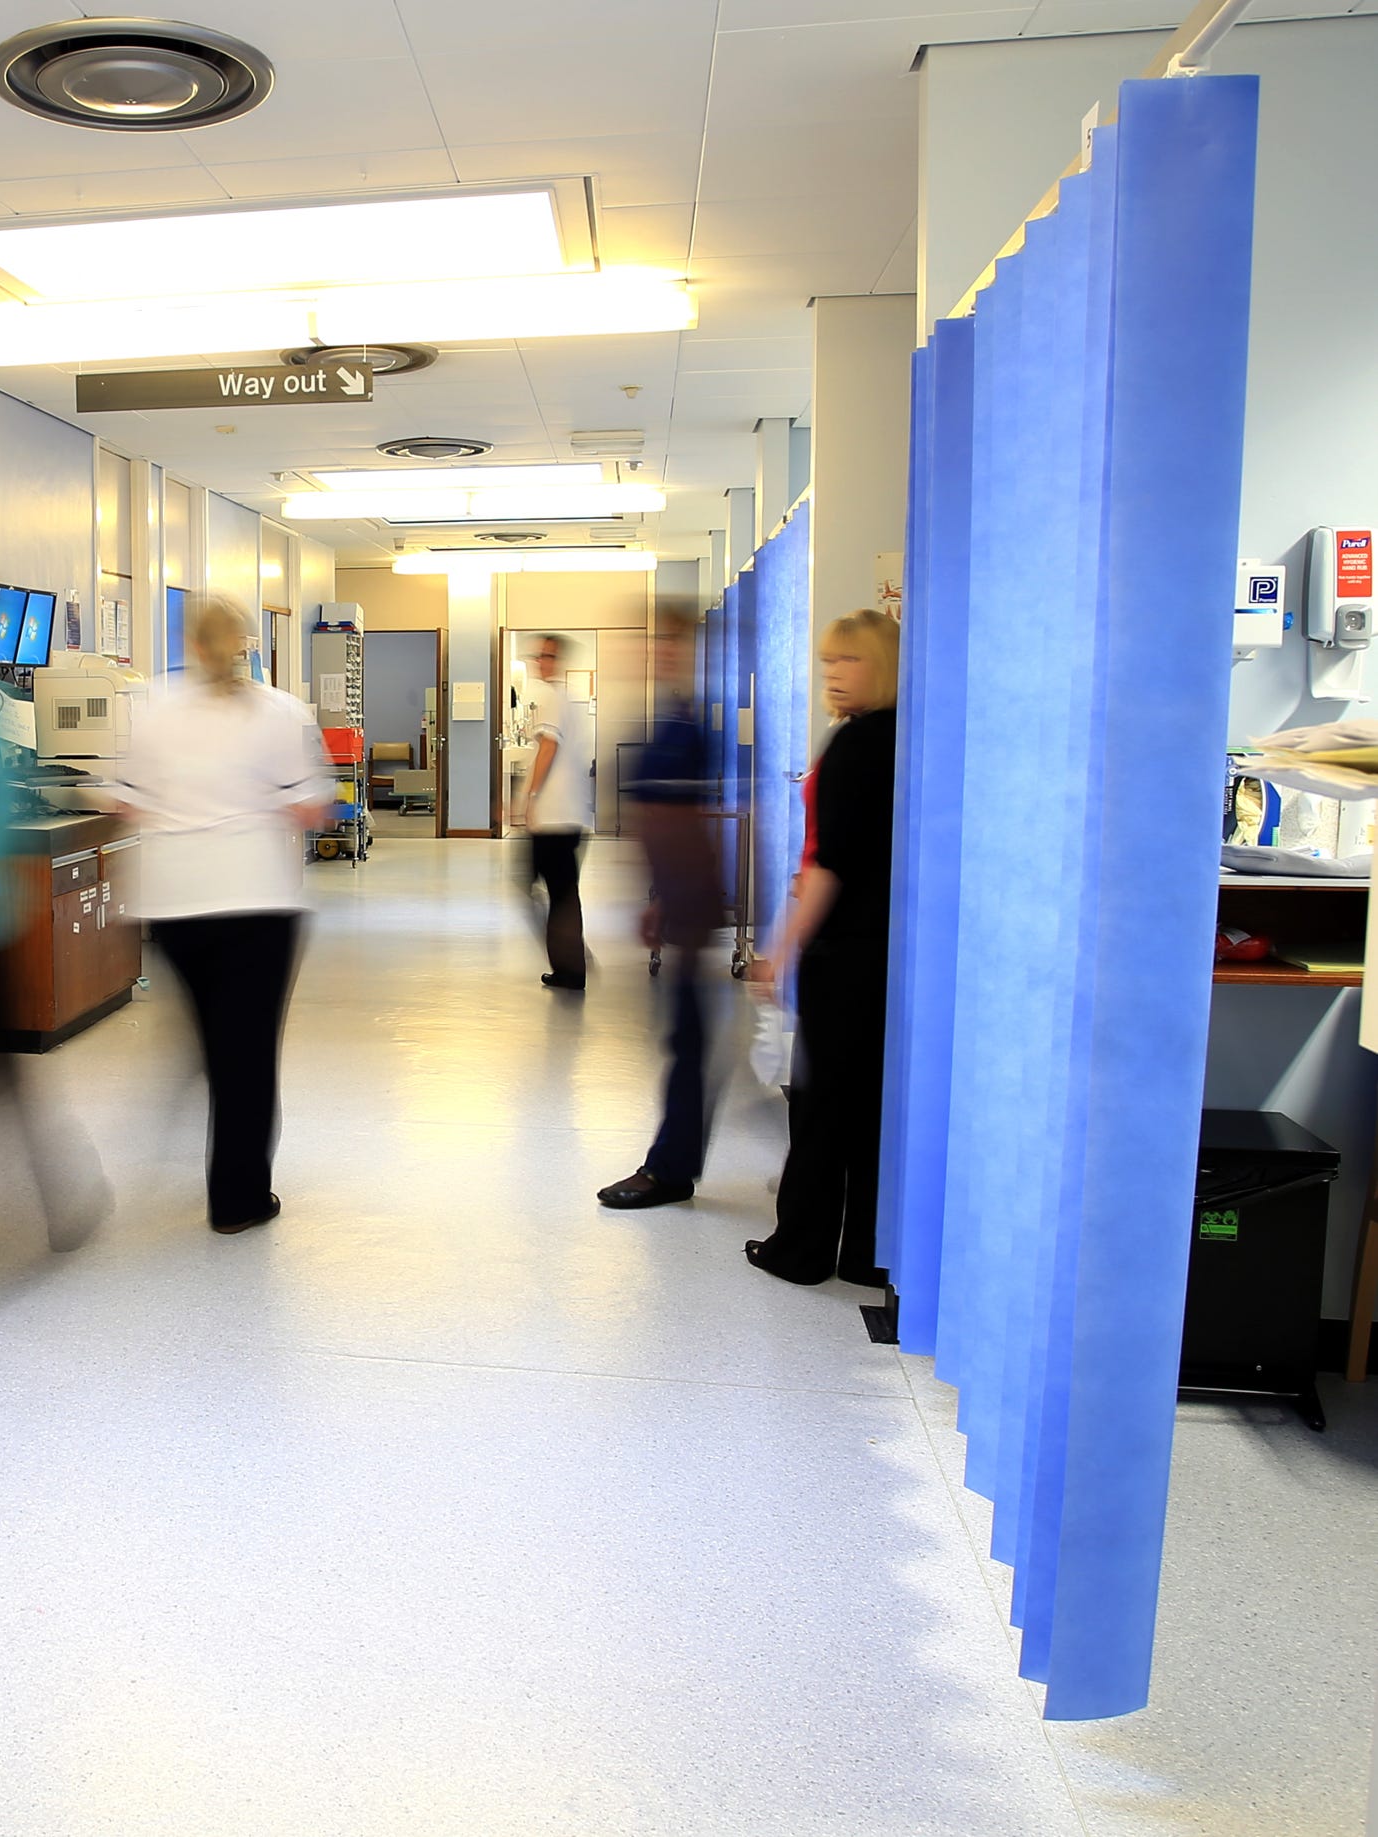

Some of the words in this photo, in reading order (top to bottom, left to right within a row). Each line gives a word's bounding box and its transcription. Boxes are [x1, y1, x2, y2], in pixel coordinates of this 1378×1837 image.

[218, 373, 275, 399] Way
[283, 369, 326, 394] out
[1342, 538, 1367, 548] Purell
